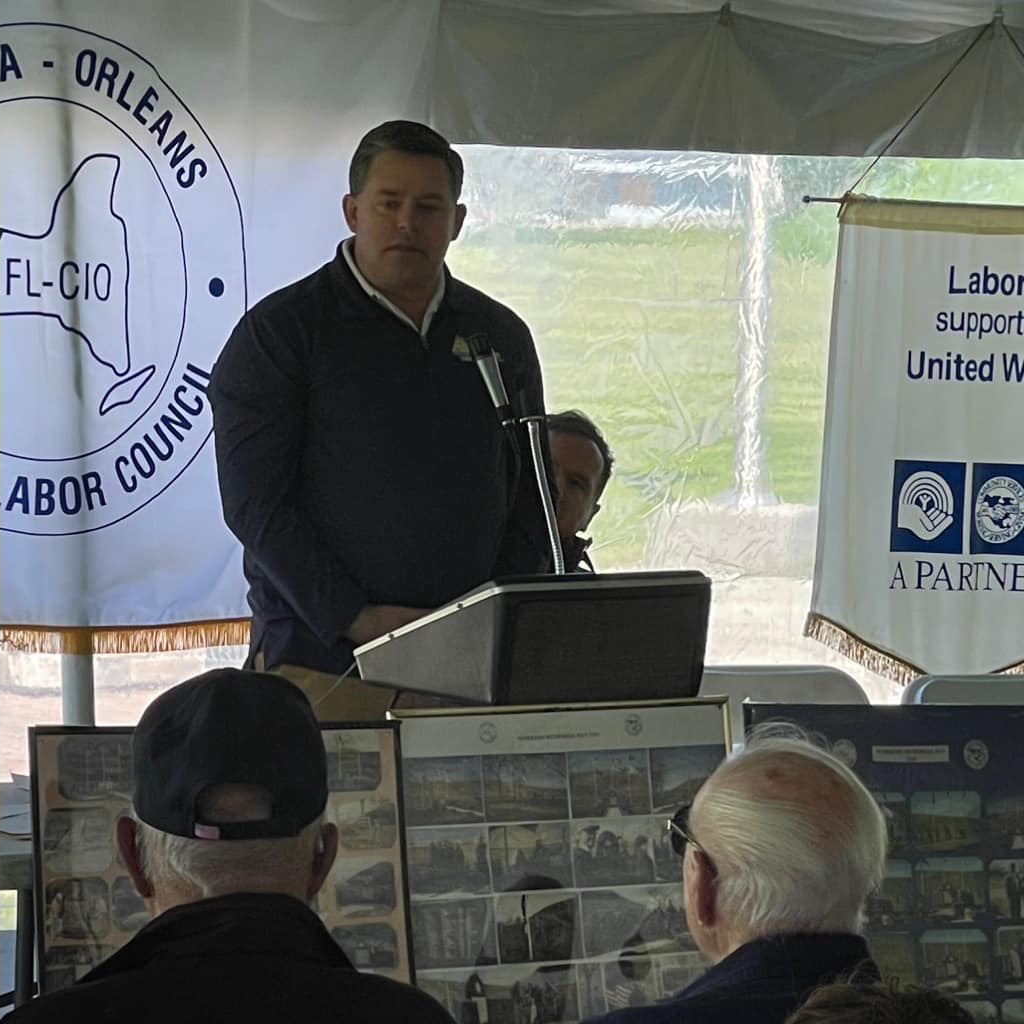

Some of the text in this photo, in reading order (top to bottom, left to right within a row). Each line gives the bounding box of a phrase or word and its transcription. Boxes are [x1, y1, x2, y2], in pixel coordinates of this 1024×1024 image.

[76, 48, 208, 189] ORLEANS
[948, 266, 1024, 296] Labor
[907, 351, 994, 382] United
[0, 471, 107, 516] ABOR
[889, 560, 906, 589] A
